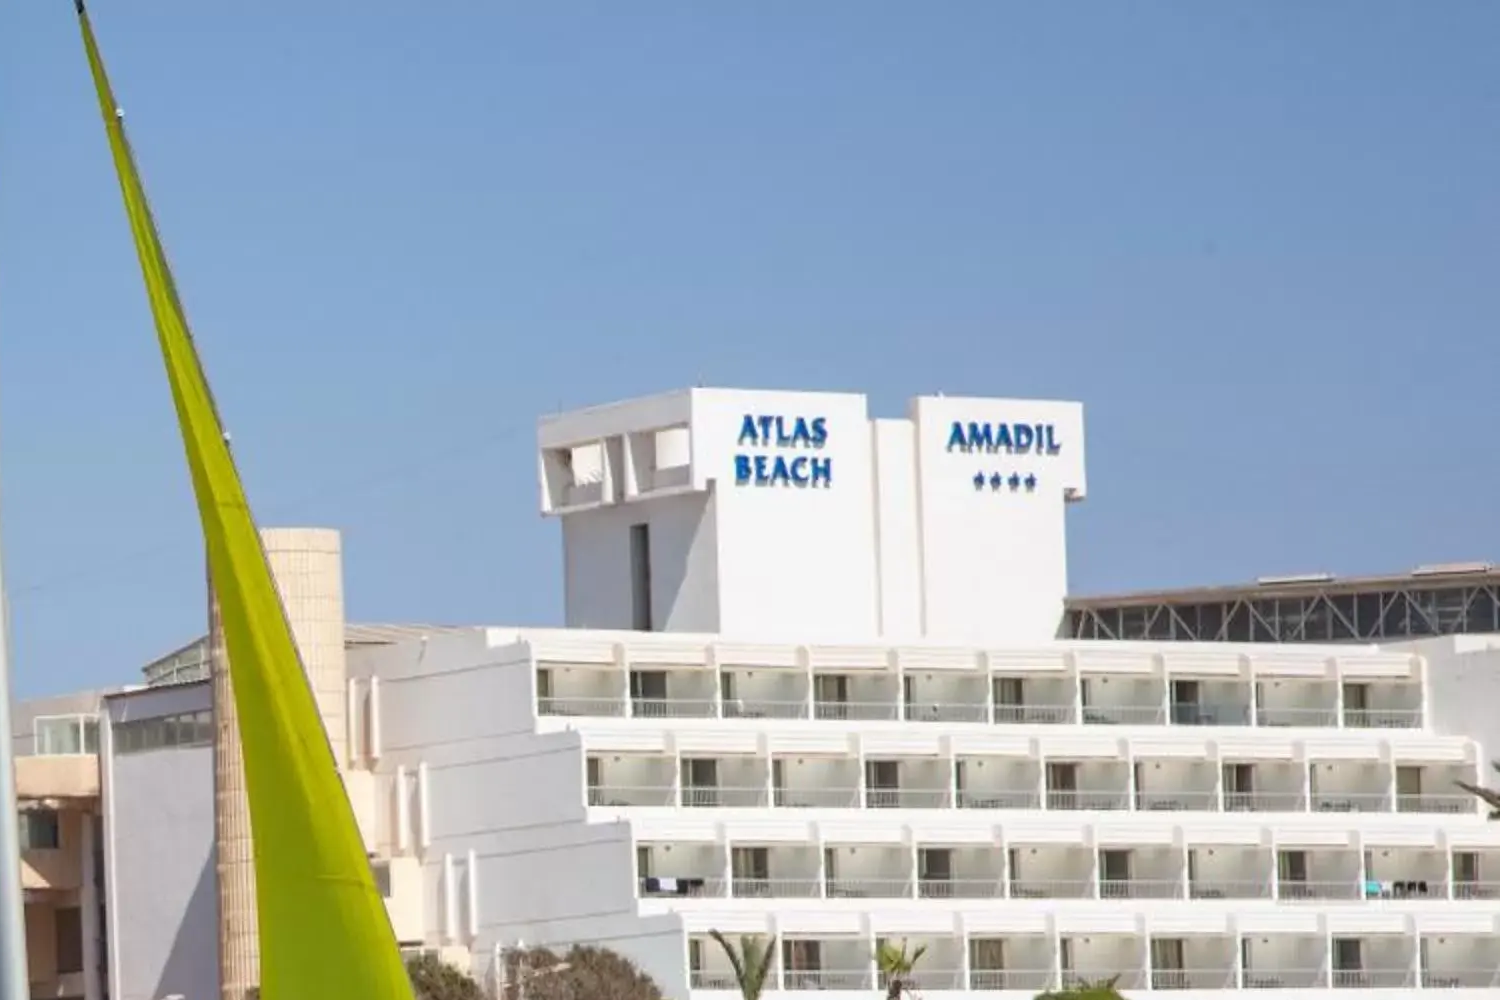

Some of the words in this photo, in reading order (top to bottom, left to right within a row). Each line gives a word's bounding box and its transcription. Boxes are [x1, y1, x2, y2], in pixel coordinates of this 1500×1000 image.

[737, 413, 828, 447] ATLAS
[945, 421, 1061, 454] AMADIL
[733, 454, 832, 487] BEACH
